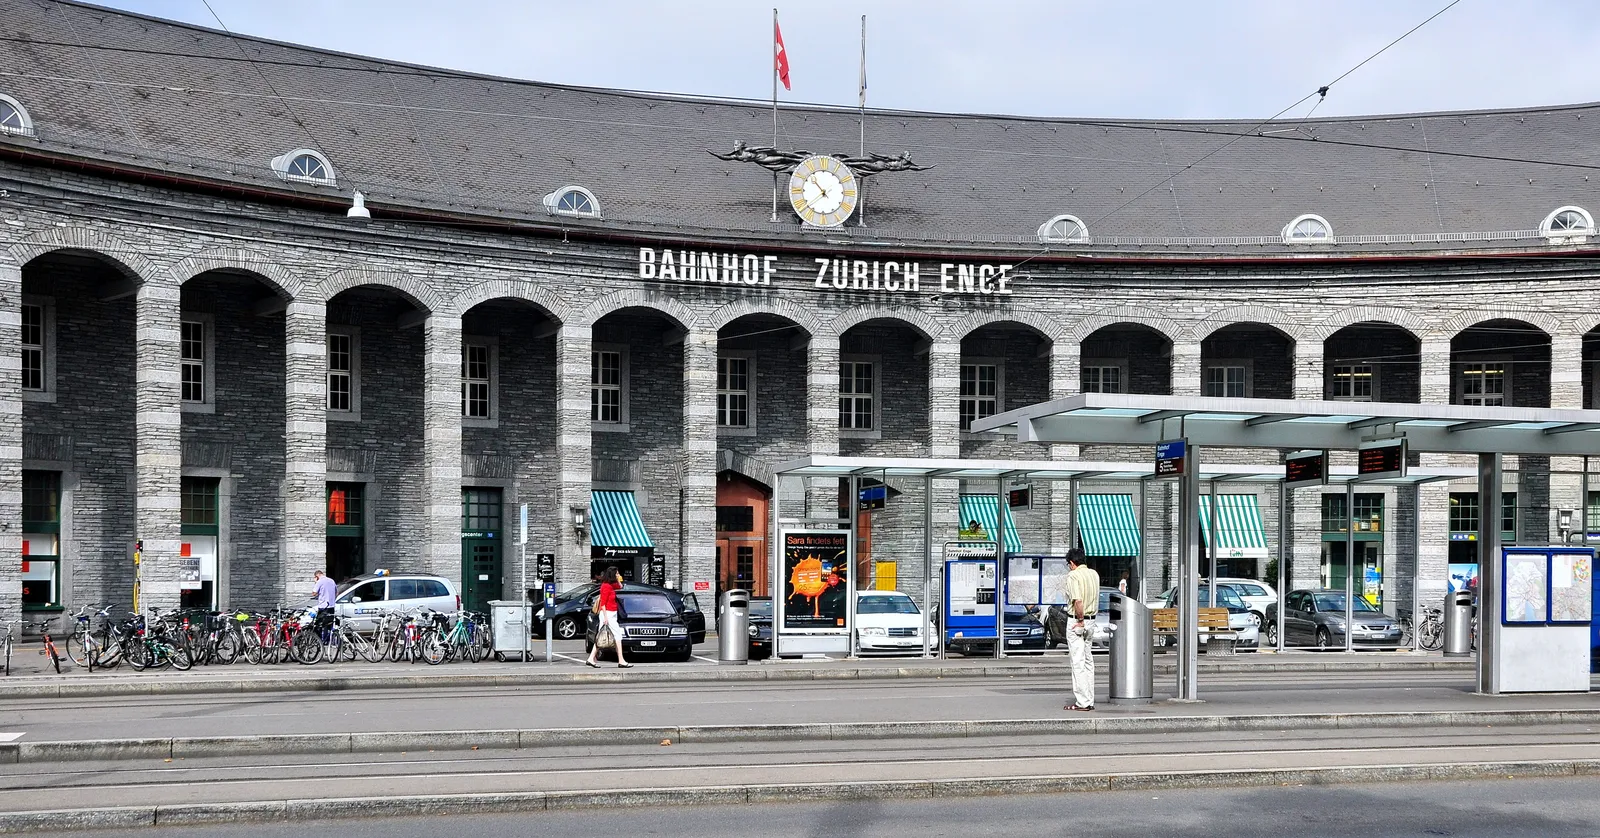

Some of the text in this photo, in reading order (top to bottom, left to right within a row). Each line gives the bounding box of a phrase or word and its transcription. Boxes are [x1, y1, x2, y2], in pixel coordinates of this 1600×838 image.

[640, 247, 778, 285] BAHNHOF
[940, 263, 1013, 294] ENGE
[1160, 463, 1164, 472] 5
[787, 536, 805, 545] Sara
